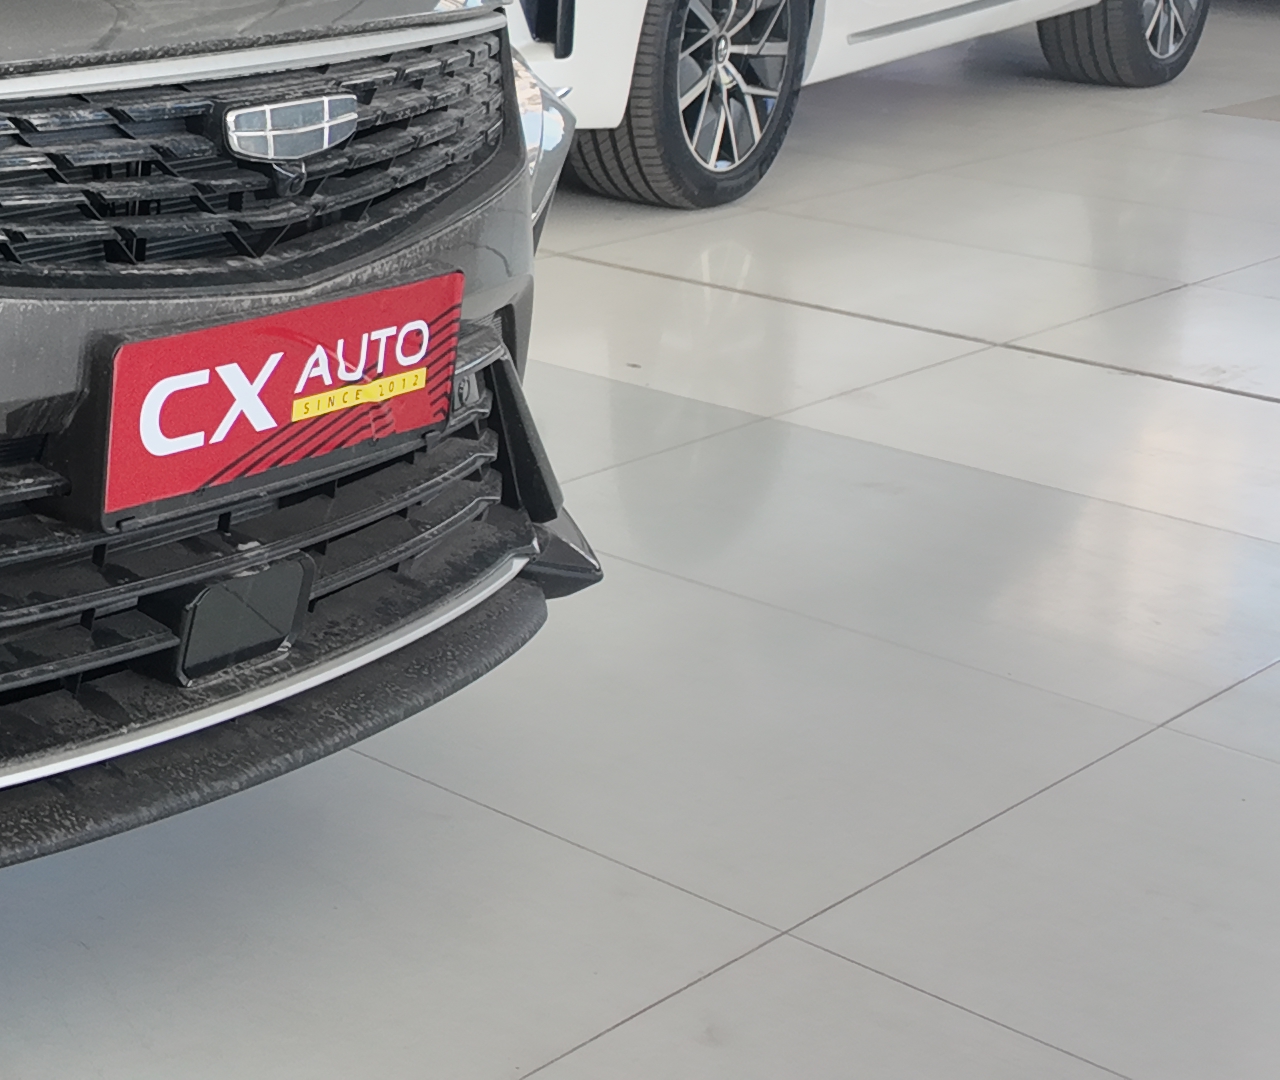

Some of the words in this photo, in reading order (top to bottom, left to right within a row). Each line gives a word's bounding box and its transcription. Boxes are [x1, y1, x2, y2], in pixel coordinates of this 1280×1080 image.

[139, 351, 285, 457] CX
[294, 319, 430, 394] AUTO
[303, 389, 363, 415] SINCE
[377, 373, 422, 398] 2012
